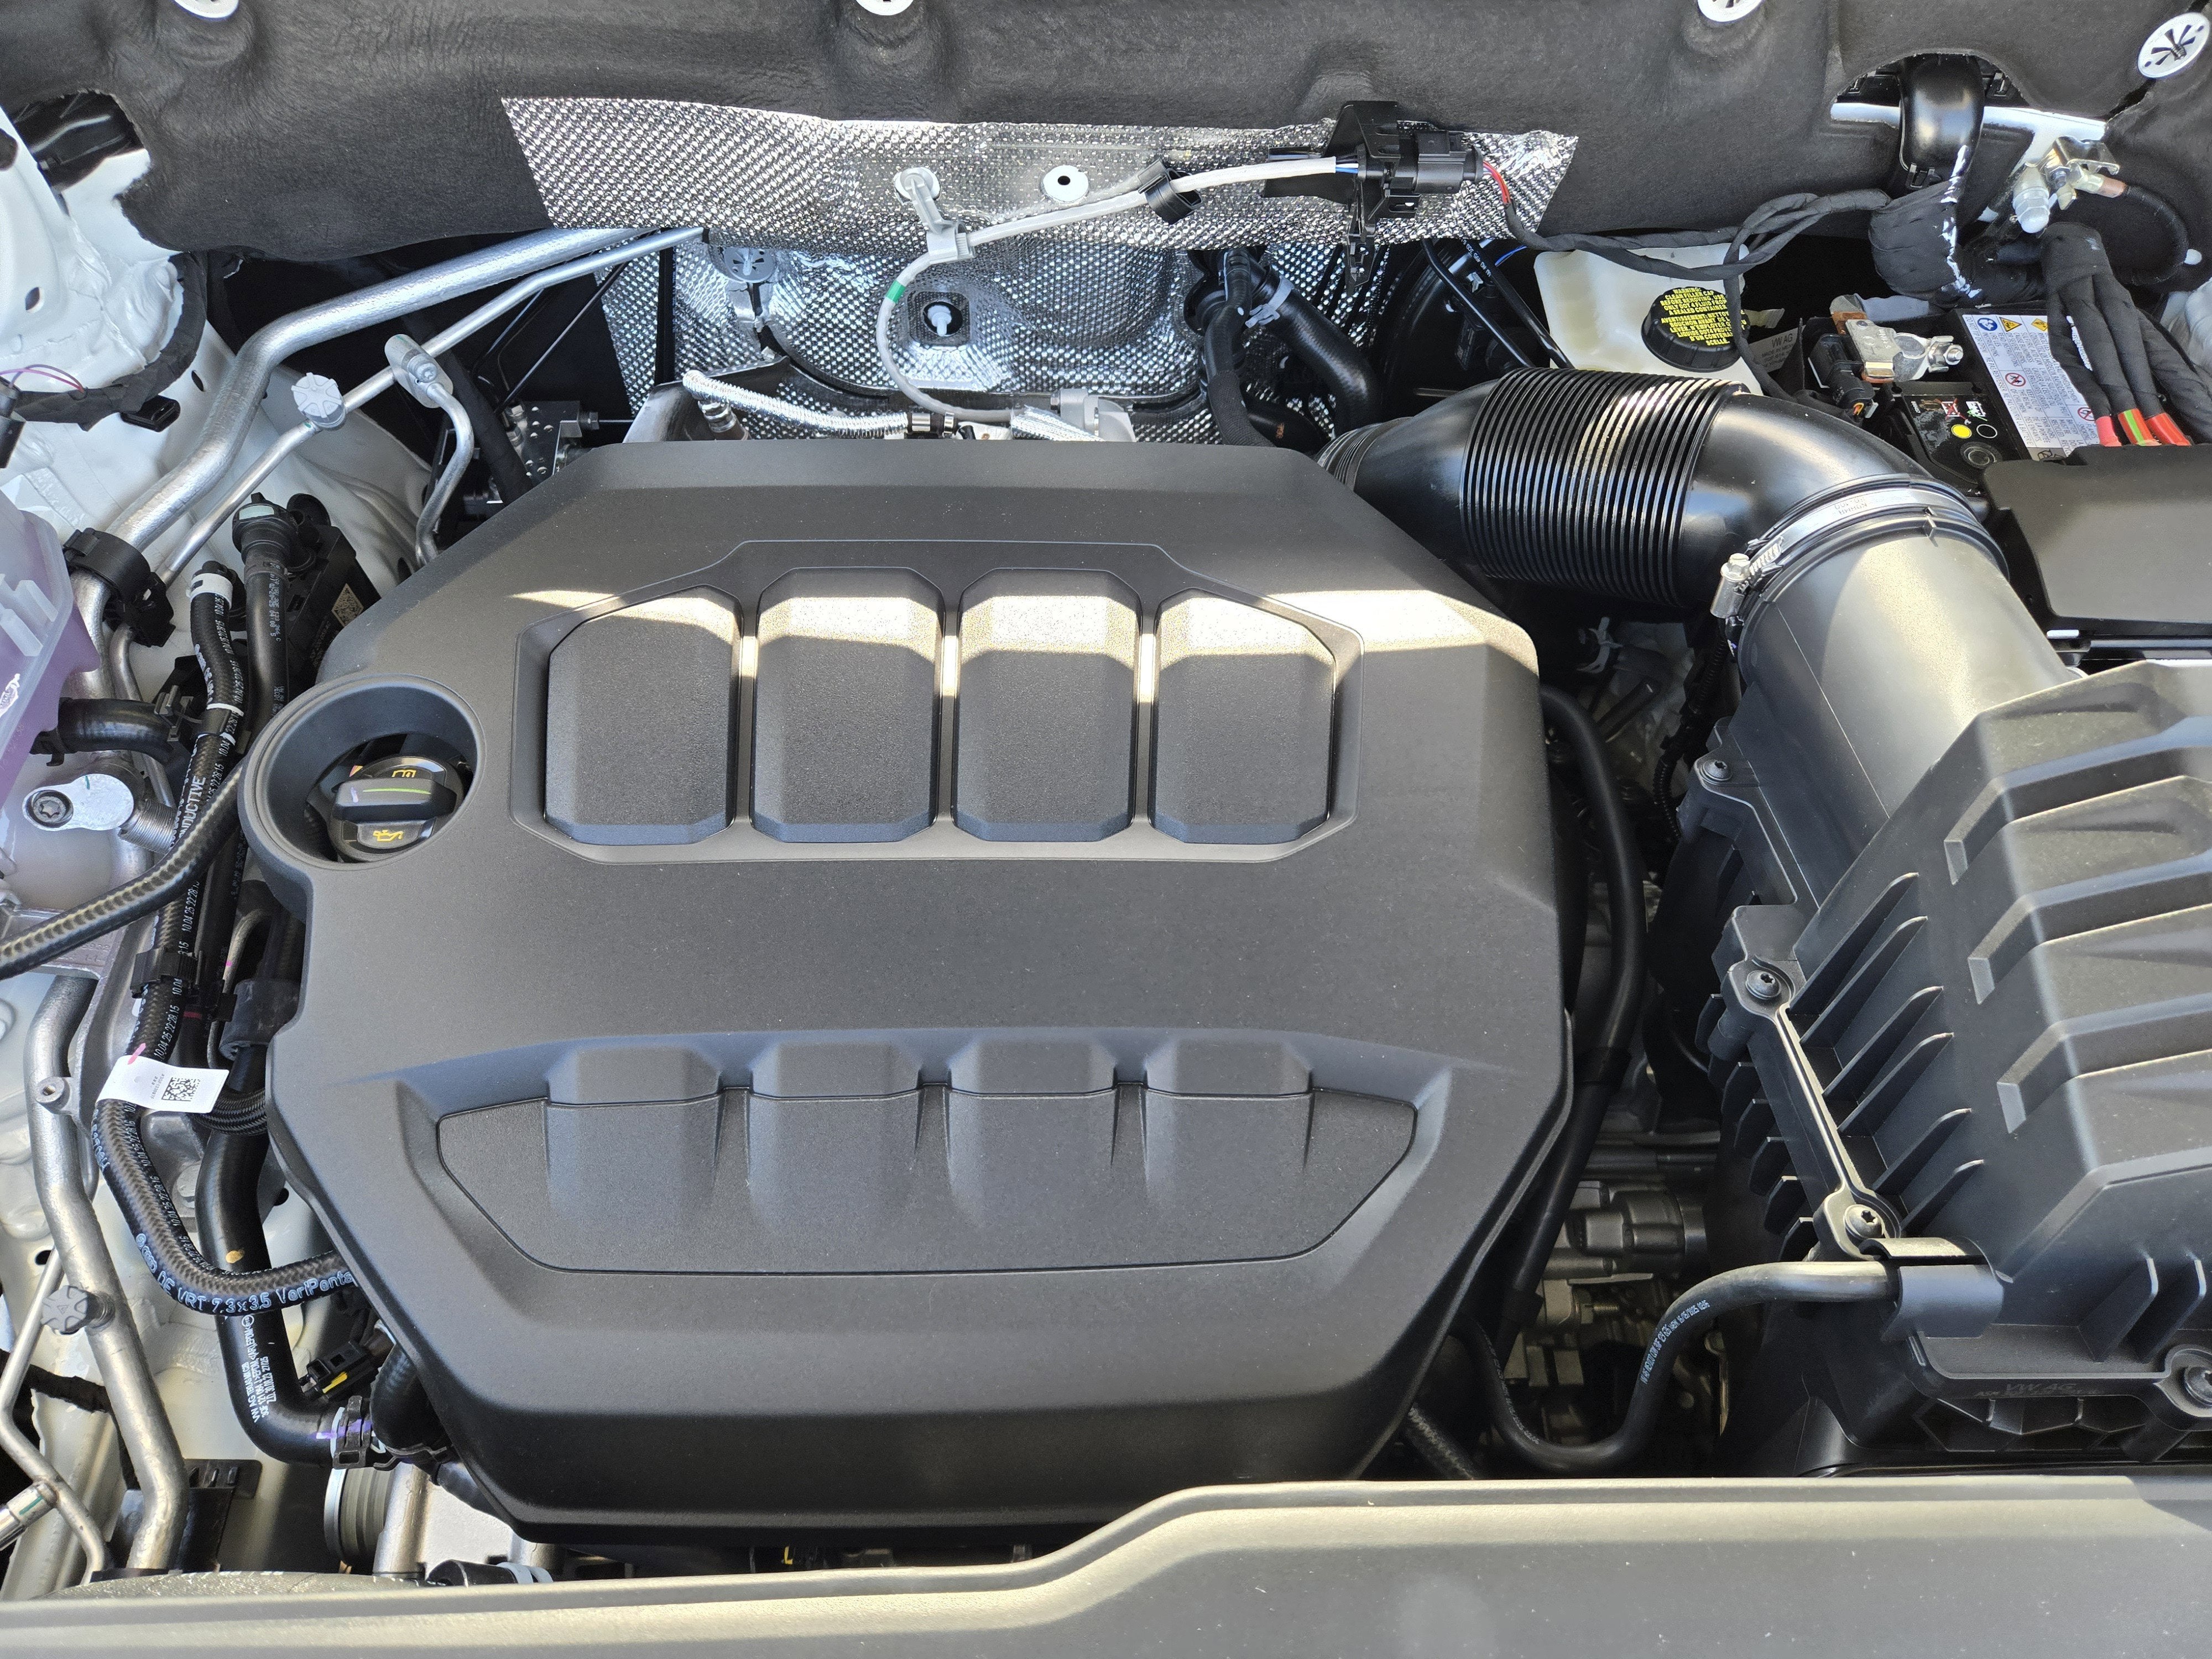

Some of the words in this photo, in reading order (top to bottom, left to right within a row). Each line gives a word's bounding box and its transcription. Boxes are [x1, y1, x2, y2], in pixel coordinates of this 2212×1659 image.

[1669, 320, 1698, 328] BOUCHON
[1968, 322, 1978, 331] NOT
[1676, 330, 1700, 338] LIQUIDE
[1996, 332, 2007, 342] READ
[2001, 342, 2020, 367] INSTRUCTIONS
[2058, 406, 2070, 416] PEUT
[2056, 419, 2069, 429] MUST
[2064, 419, 2080, 435] BATTERY
[172, 1285, 208, 1312] VRT
[247, 1394, 257, 1407] AG
[255, 1392, 267, 1405] 121
[250, 1406, 261, 1423] VW
